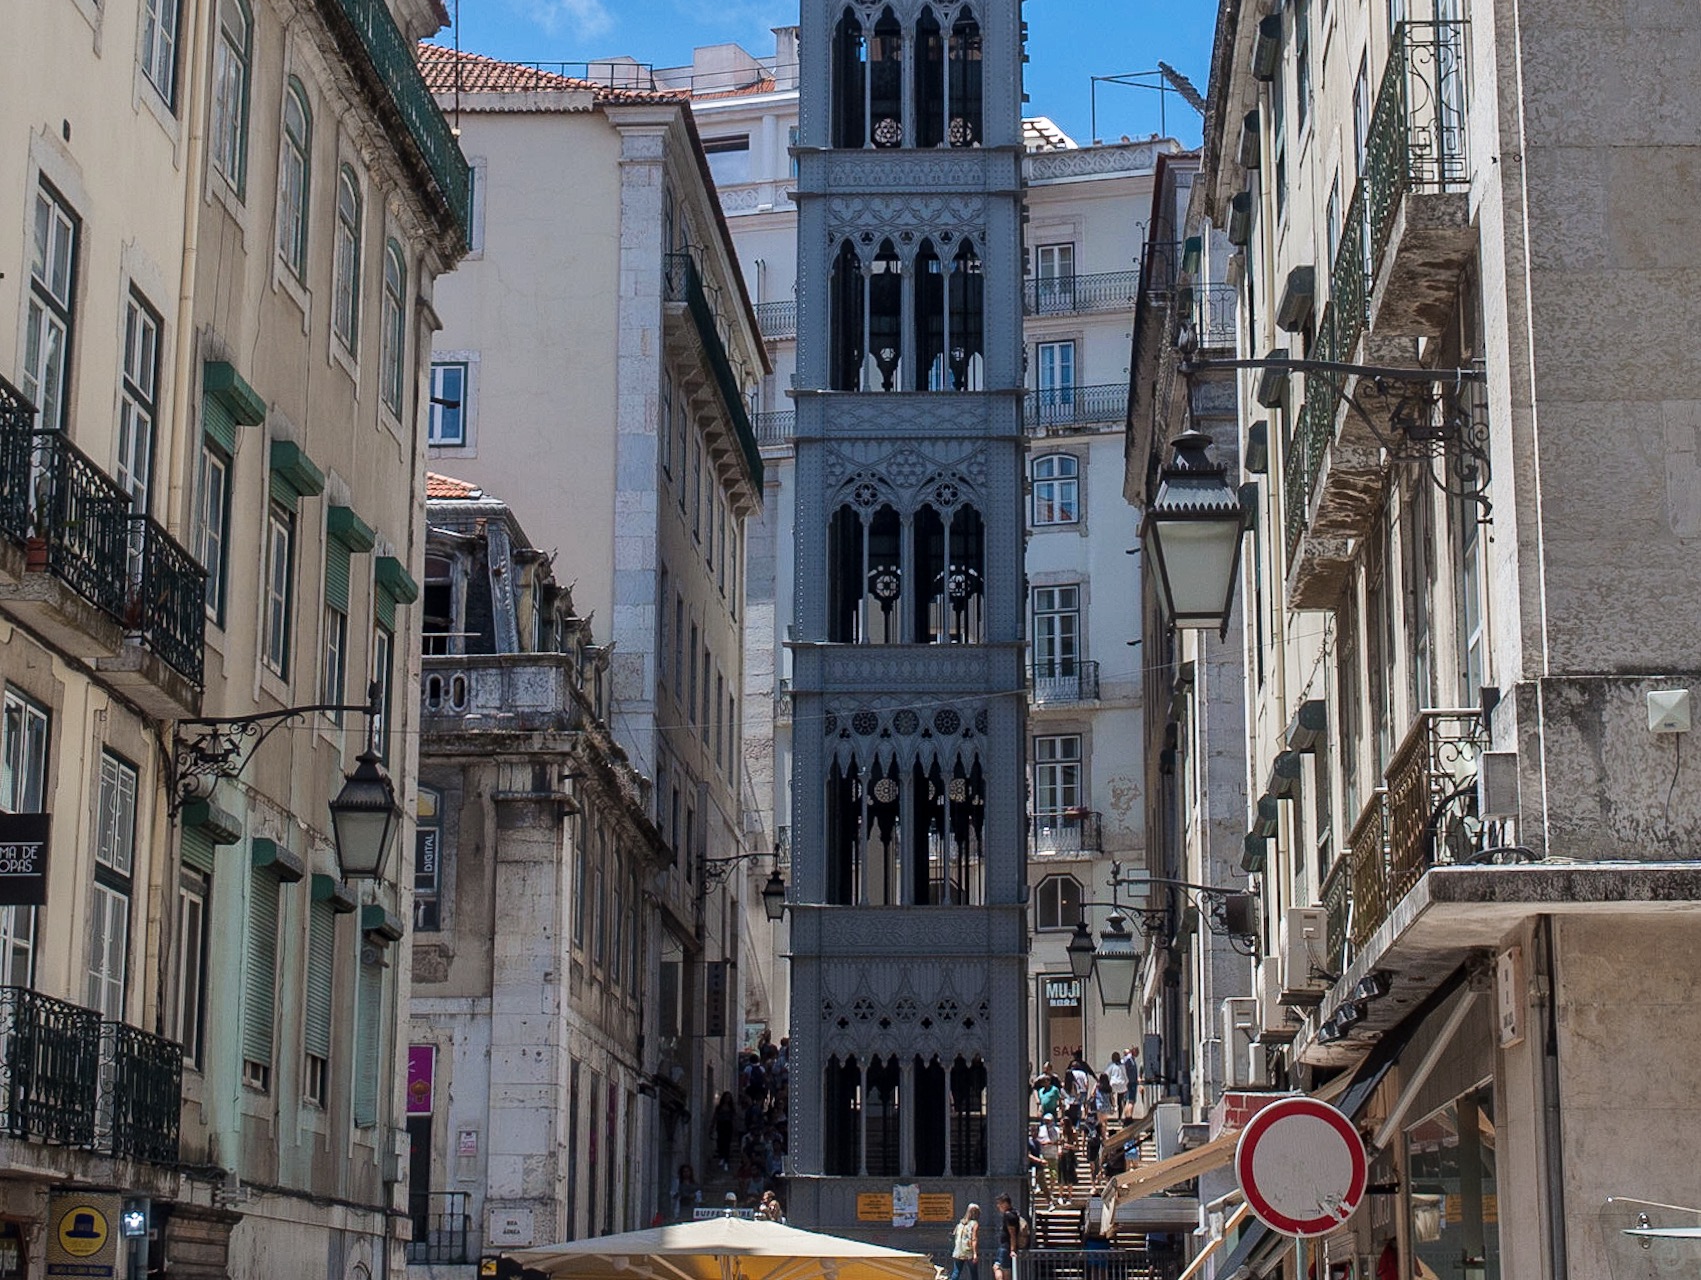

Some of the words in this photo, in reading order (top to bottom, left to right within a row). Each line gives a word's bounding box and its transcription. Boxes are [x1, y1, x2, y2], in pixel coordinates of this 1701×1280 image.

[22, 846, 38, 859] DE
[424, 833, 434, 872] DIGITAL
[1046, 981, 1080, 999] MUJI
